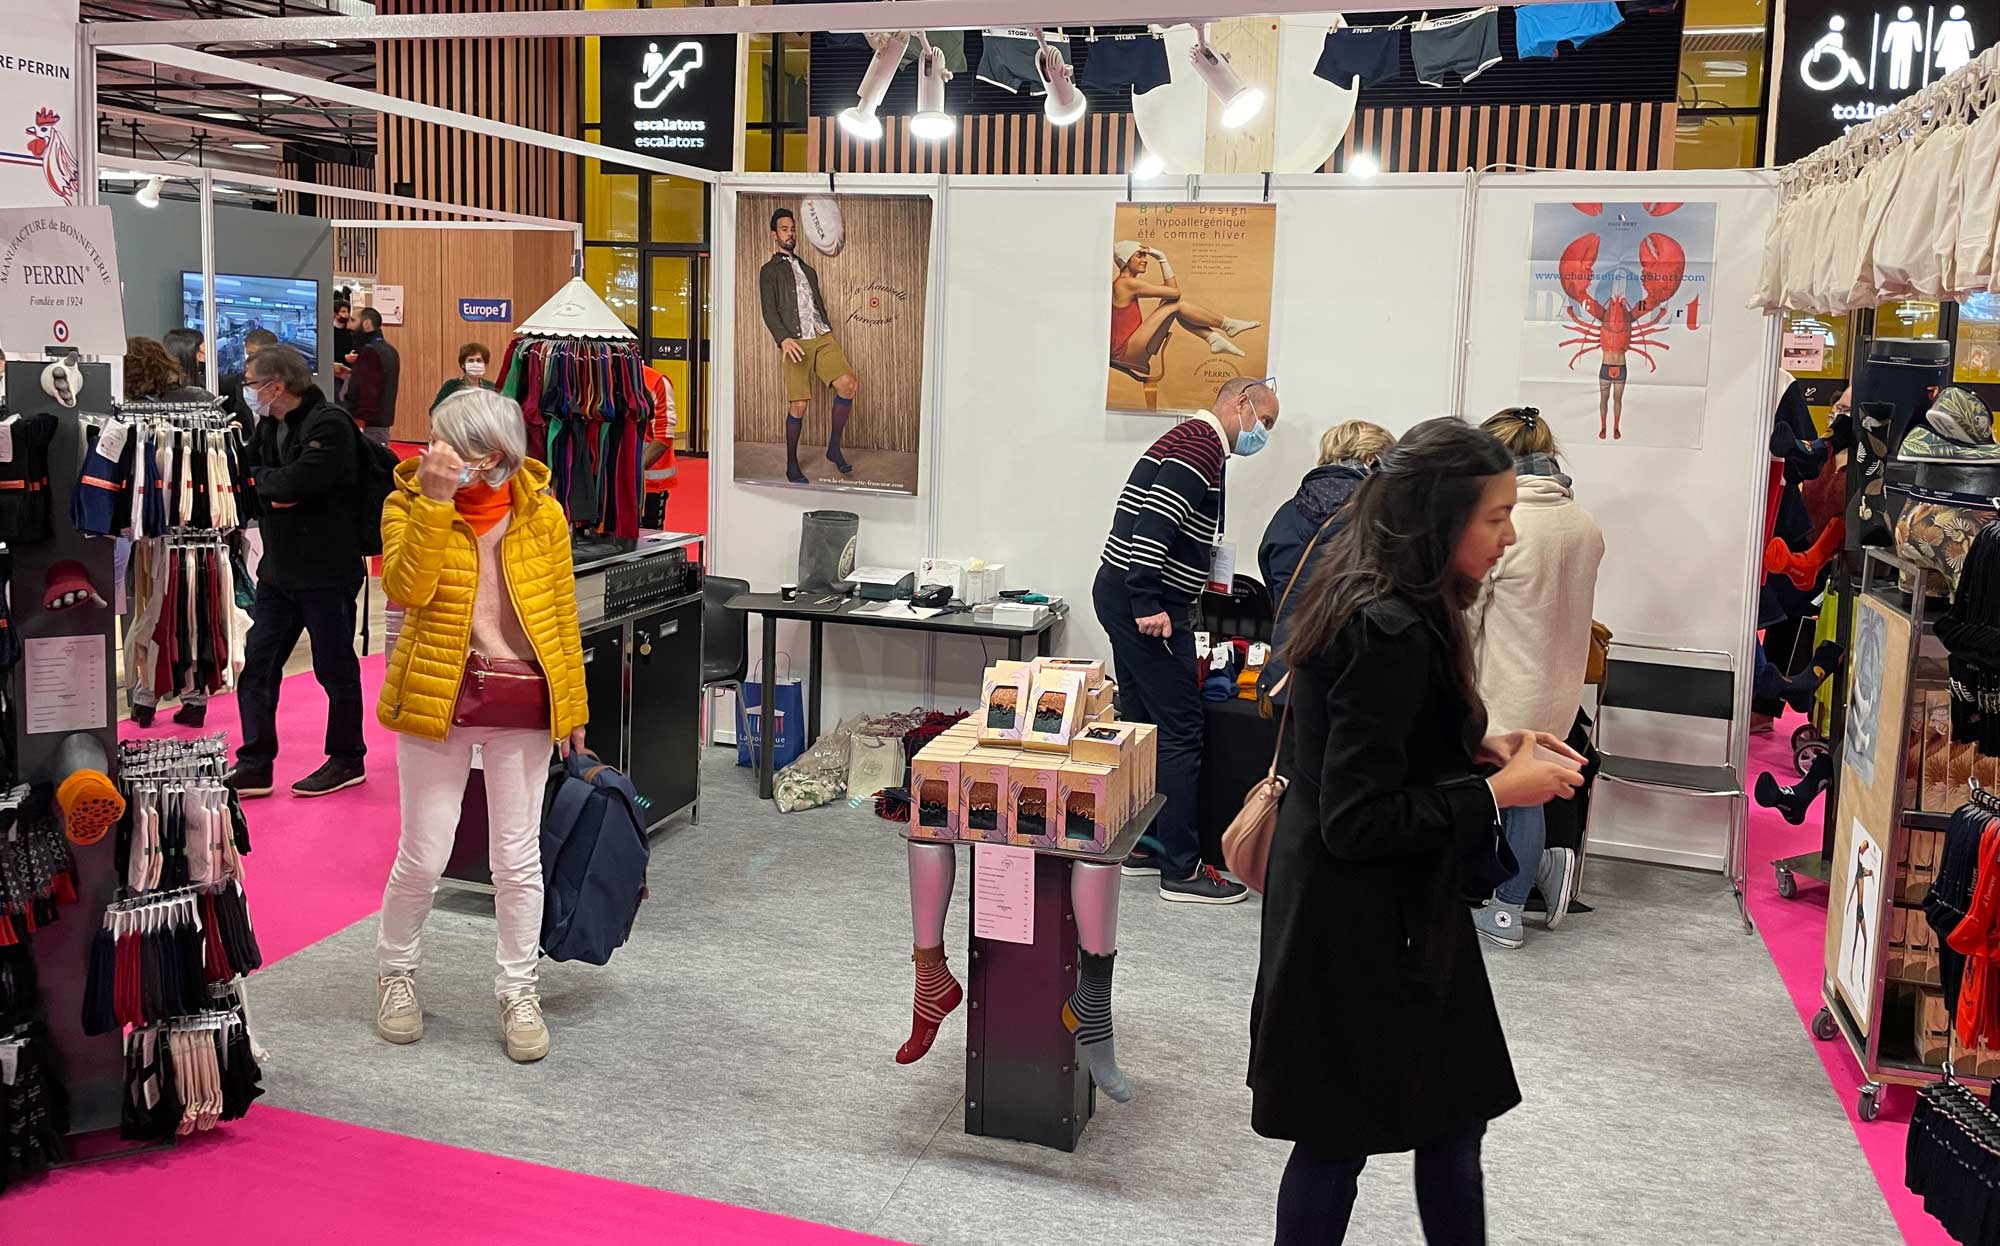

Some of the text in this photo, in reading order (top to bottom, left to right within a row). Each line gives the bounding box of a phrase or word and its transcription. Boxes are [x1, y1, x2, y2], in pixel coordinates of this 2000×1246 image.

[18, 58, 70, 80] PERRIN
[633, 118, 706, 131] escalators
[634, 135, 705, 148] escalators
[1199, 204, 1248, 217] Design
[809, 206, 826, 241] PATRICK
[1138, 216, 1247, 233] et hypoallergénique
[1137, 229, 1247, 240] été comme hiver
[0, 219, 112, 286] MANUFACTURE de BONNETERIE
[55, 298, 65, 306] en
[66, 296, 84, 307] 1924
